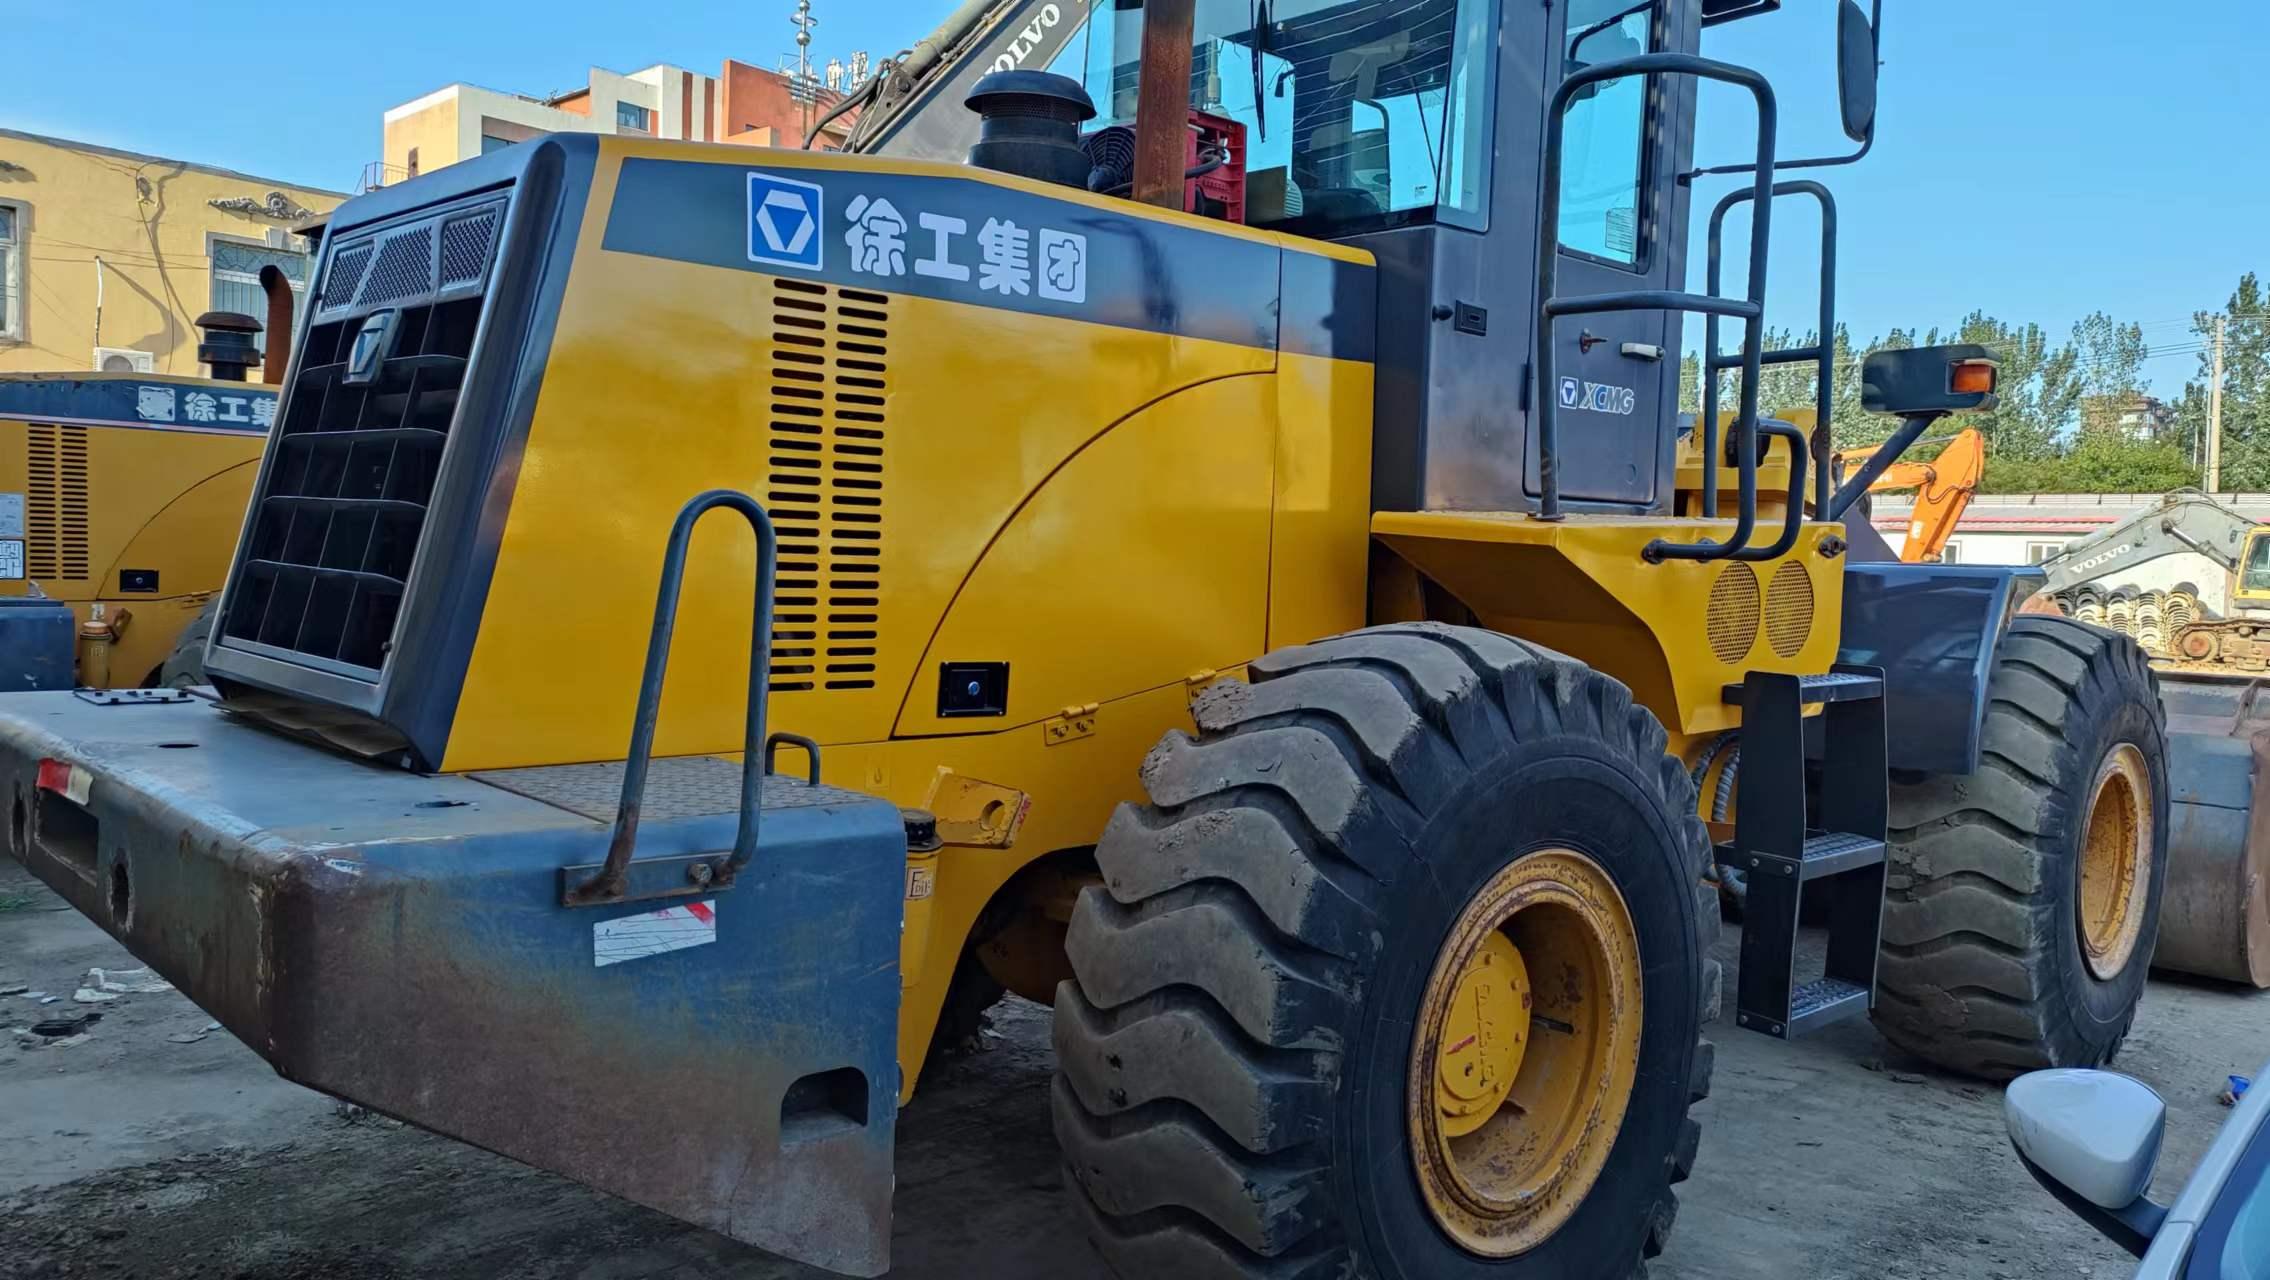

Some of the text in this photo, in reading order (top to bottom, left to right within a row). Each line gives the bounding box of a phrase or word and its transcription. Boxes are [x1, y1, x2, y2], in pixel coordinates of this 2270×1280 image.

[845, 194, 1087, 304] 徐工集团
[1578, 381, 1634, 415] XCMG
[2069, 544, 2130, 573] VOLVO
